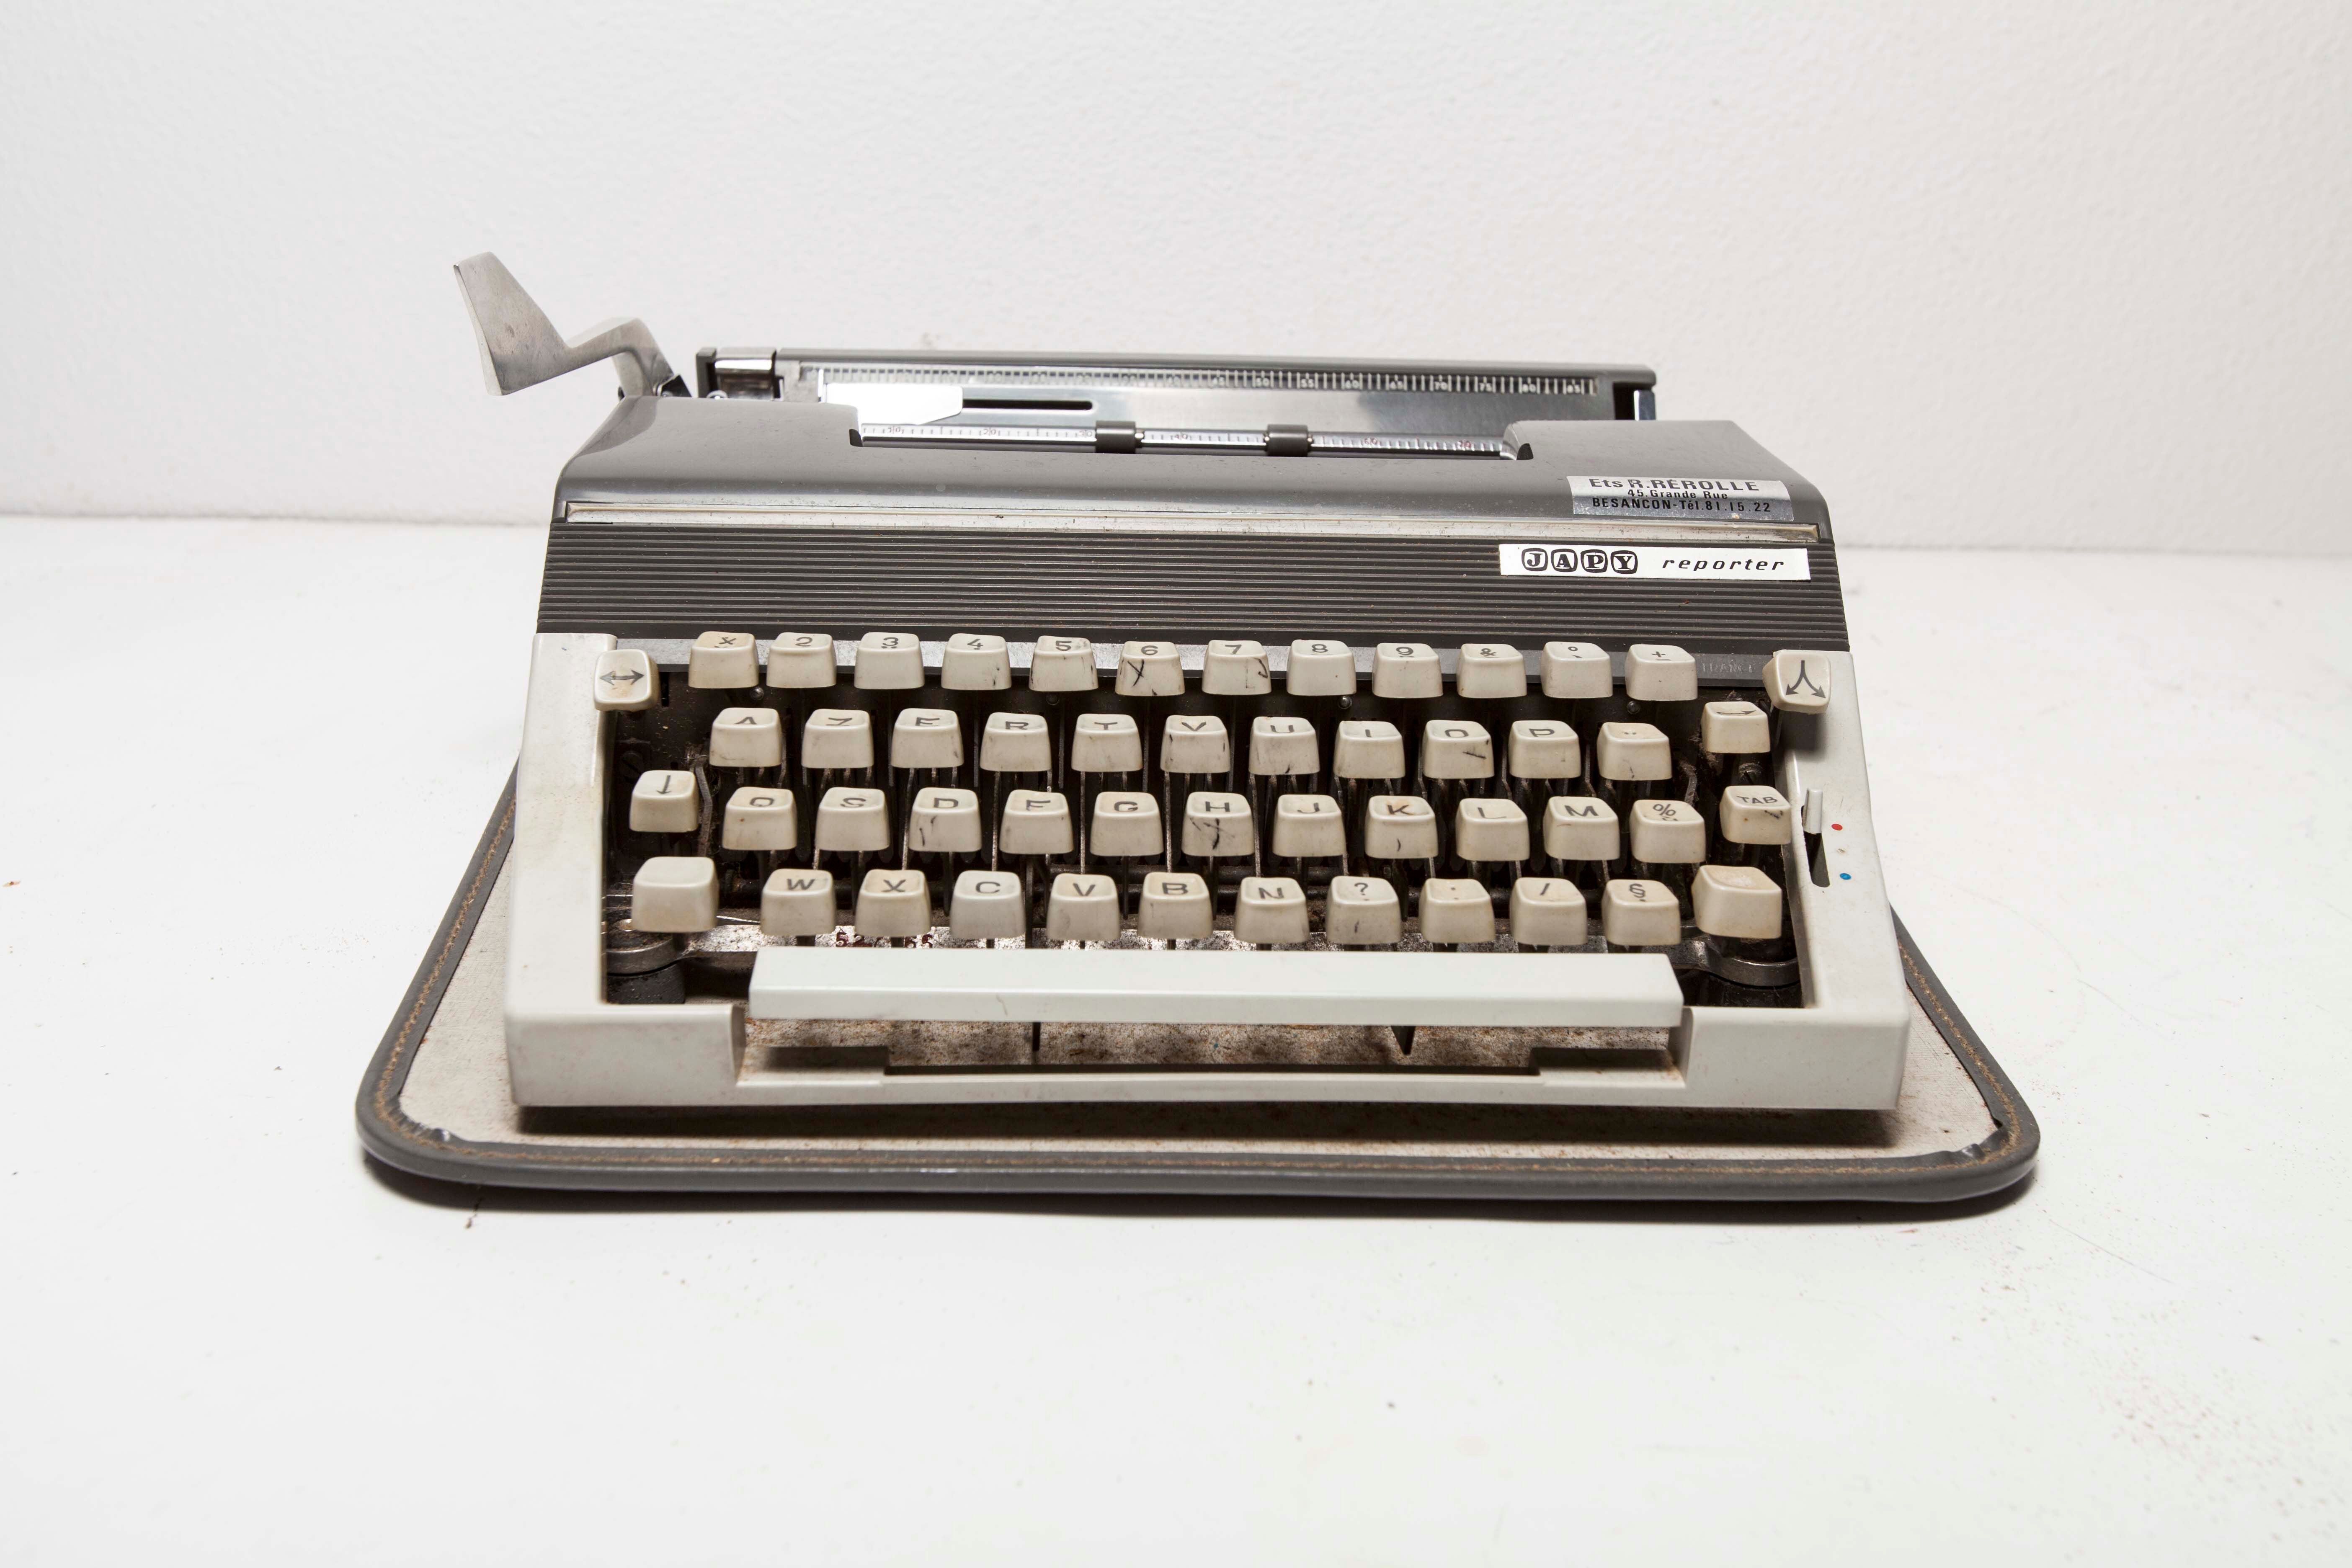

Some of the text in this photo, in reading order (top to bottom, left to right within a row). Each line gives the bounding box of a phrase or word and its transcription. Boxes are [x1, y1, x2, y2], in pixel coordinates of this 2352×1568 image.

[1589, 478, 1623, 488] Ets
[1703, 491, 1728, 500] Rue
[1525, 551, 1784, 572] JAPY reporter
[795, 637, 813, 647] 2
[882, 637, 899, 646] 3
[967, 638, 983, 648] 4
[1055, 640, 1072, 651] 5
[1141, 645, 1158, 656] 6
[1225, 644, 1242, 655] 7
[1311, 644, 1328, 653] 8
[1396, 647, 1414, 655] 9
[1005, 721, 1029, 730] R
[1094, 722, 1118, 730] T
[1529, 728, 1555, 737] P
[840, 797, 867, 807] S
[933, 797, 959, 808] D
[1026, 799, 1051, 811] F
[1114, 801, 1138, 812] G
[1205, 801, 1230, 812] H
[1387, 805, 1413, 815] K
[1564, 805, 1599, 817] M
[1736, 796, 1778, 804] TAB
[787, 879, 815, 891] W
[882, 879, 906, 892] X
[975, 882, 1001, 893] C
[1073, 883, 1096, 897] V
[1162, 882, 1188, 895] B
[1258, 887, 1284, 899] N
